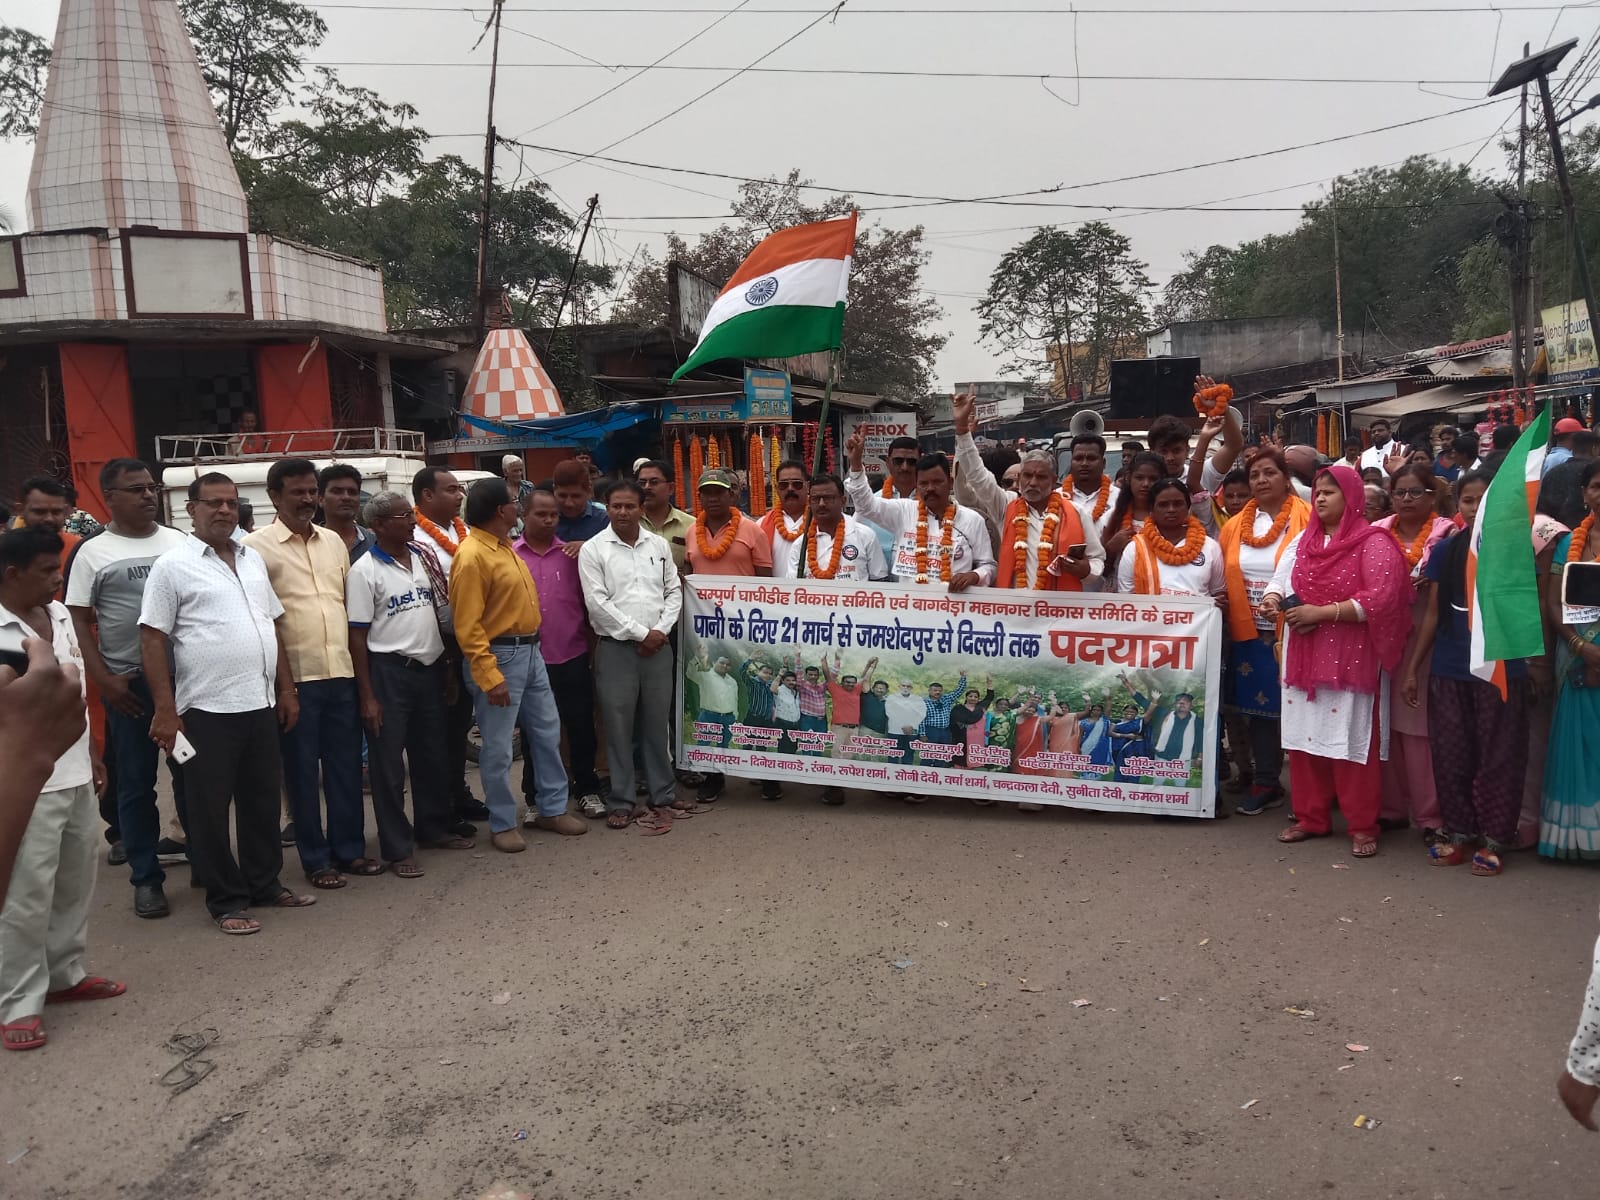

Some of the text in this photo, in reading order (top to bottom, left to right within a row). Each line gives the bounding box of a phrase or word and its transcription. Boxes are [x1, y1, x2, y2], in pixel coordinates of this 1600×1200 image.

[852, 424, 909, 436] XEROX
[127, 565, 152, 581] AUT
[387, 590, 415, 609] Just
[794, 588, 839, 608] विकास
[842, 591, 886, 609] समिति
[889, 594, 909, 610] एवं
[912, 596, 966, 617] बागबेड़ा
[969, 601, 1032, 618] महानगर
[1034, 601, 1084, 619] विकास
[1088, 603, 1137, 622] समिति
[1141, 605, 1158, 623] के
[1162, 611, 1195, 625] द्वारा
[693, 607, 1042, 666] पानी के लिए 21 मार्च से जमशेदपुर से दिल्ली तक
[1049, 630, 1199, 671] पदयात्रा
[1019, 757, 1051, 770] महिला
[1120, 766, 1154, 777] सक्रिय
[687, 749, 712, 763] सक्रिय
[713, 753, 740, 766] सदस्य
[750, 753, 777, 769] दिनेश
[838, 763, 865, 777] रूपेश
[895, 768, 919, 782] सोनी
[944, 773, 963, 786] वर्षा
[992, 778, 1039, 794] चन्द्रकला
[1066, 783, 1101, 800] सुनीता
[1128, 790, 1164, 804] कमला
[1165, 791, 1191, 805] शर्मा
